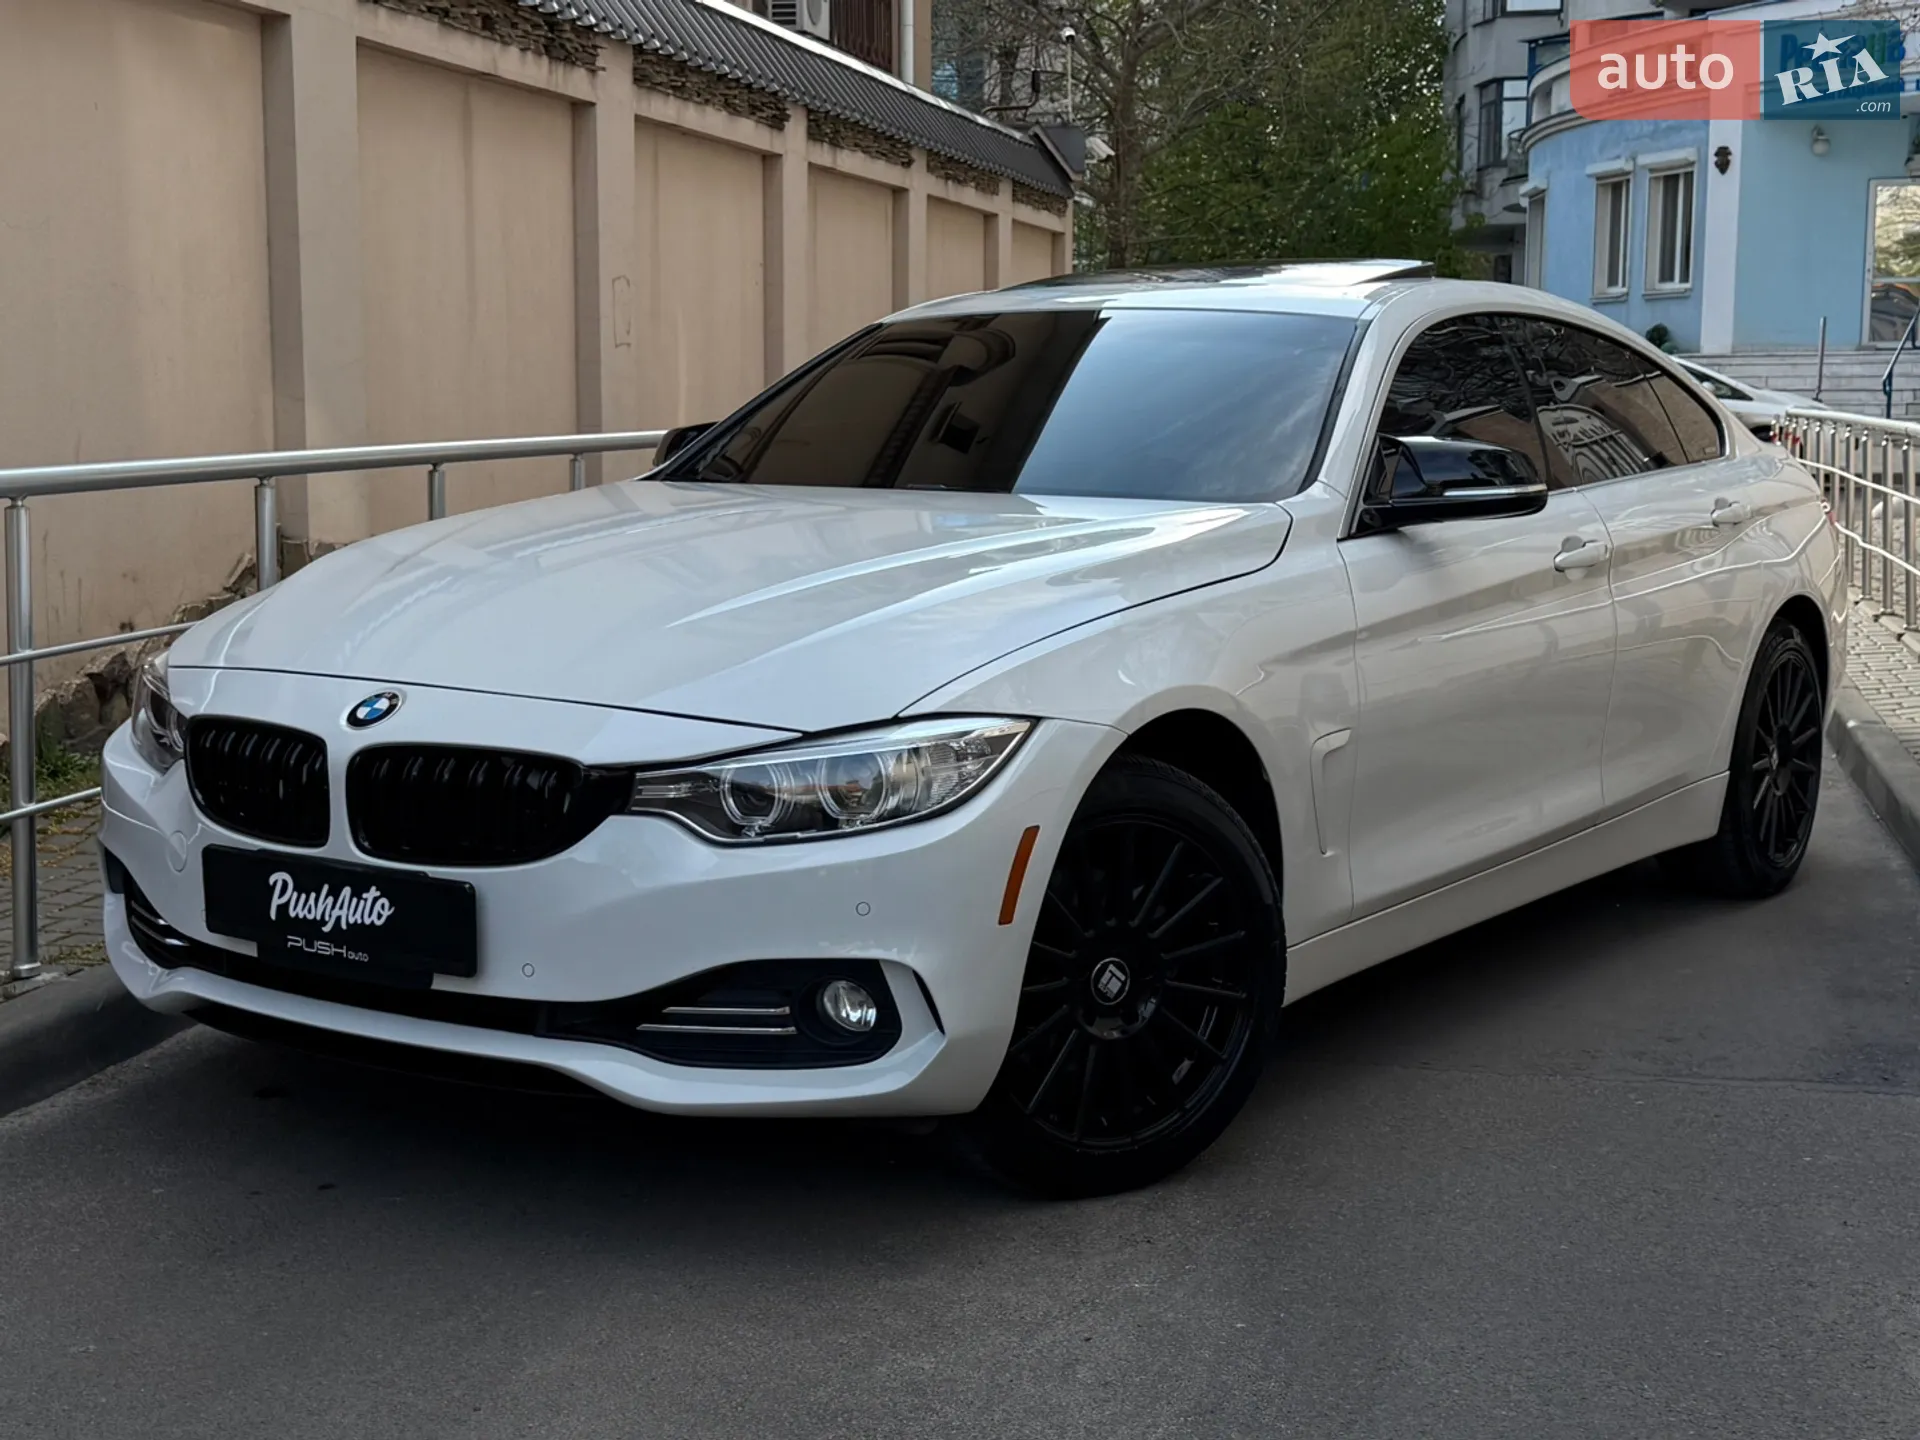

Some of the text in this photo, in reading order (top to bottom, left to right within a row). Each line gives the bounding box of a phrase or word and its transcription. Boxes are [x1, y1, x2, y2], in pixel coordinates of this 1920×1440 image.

[268, 871, 395, 932] PushAuto
[287, 935, 369, 962] PUSH auto
